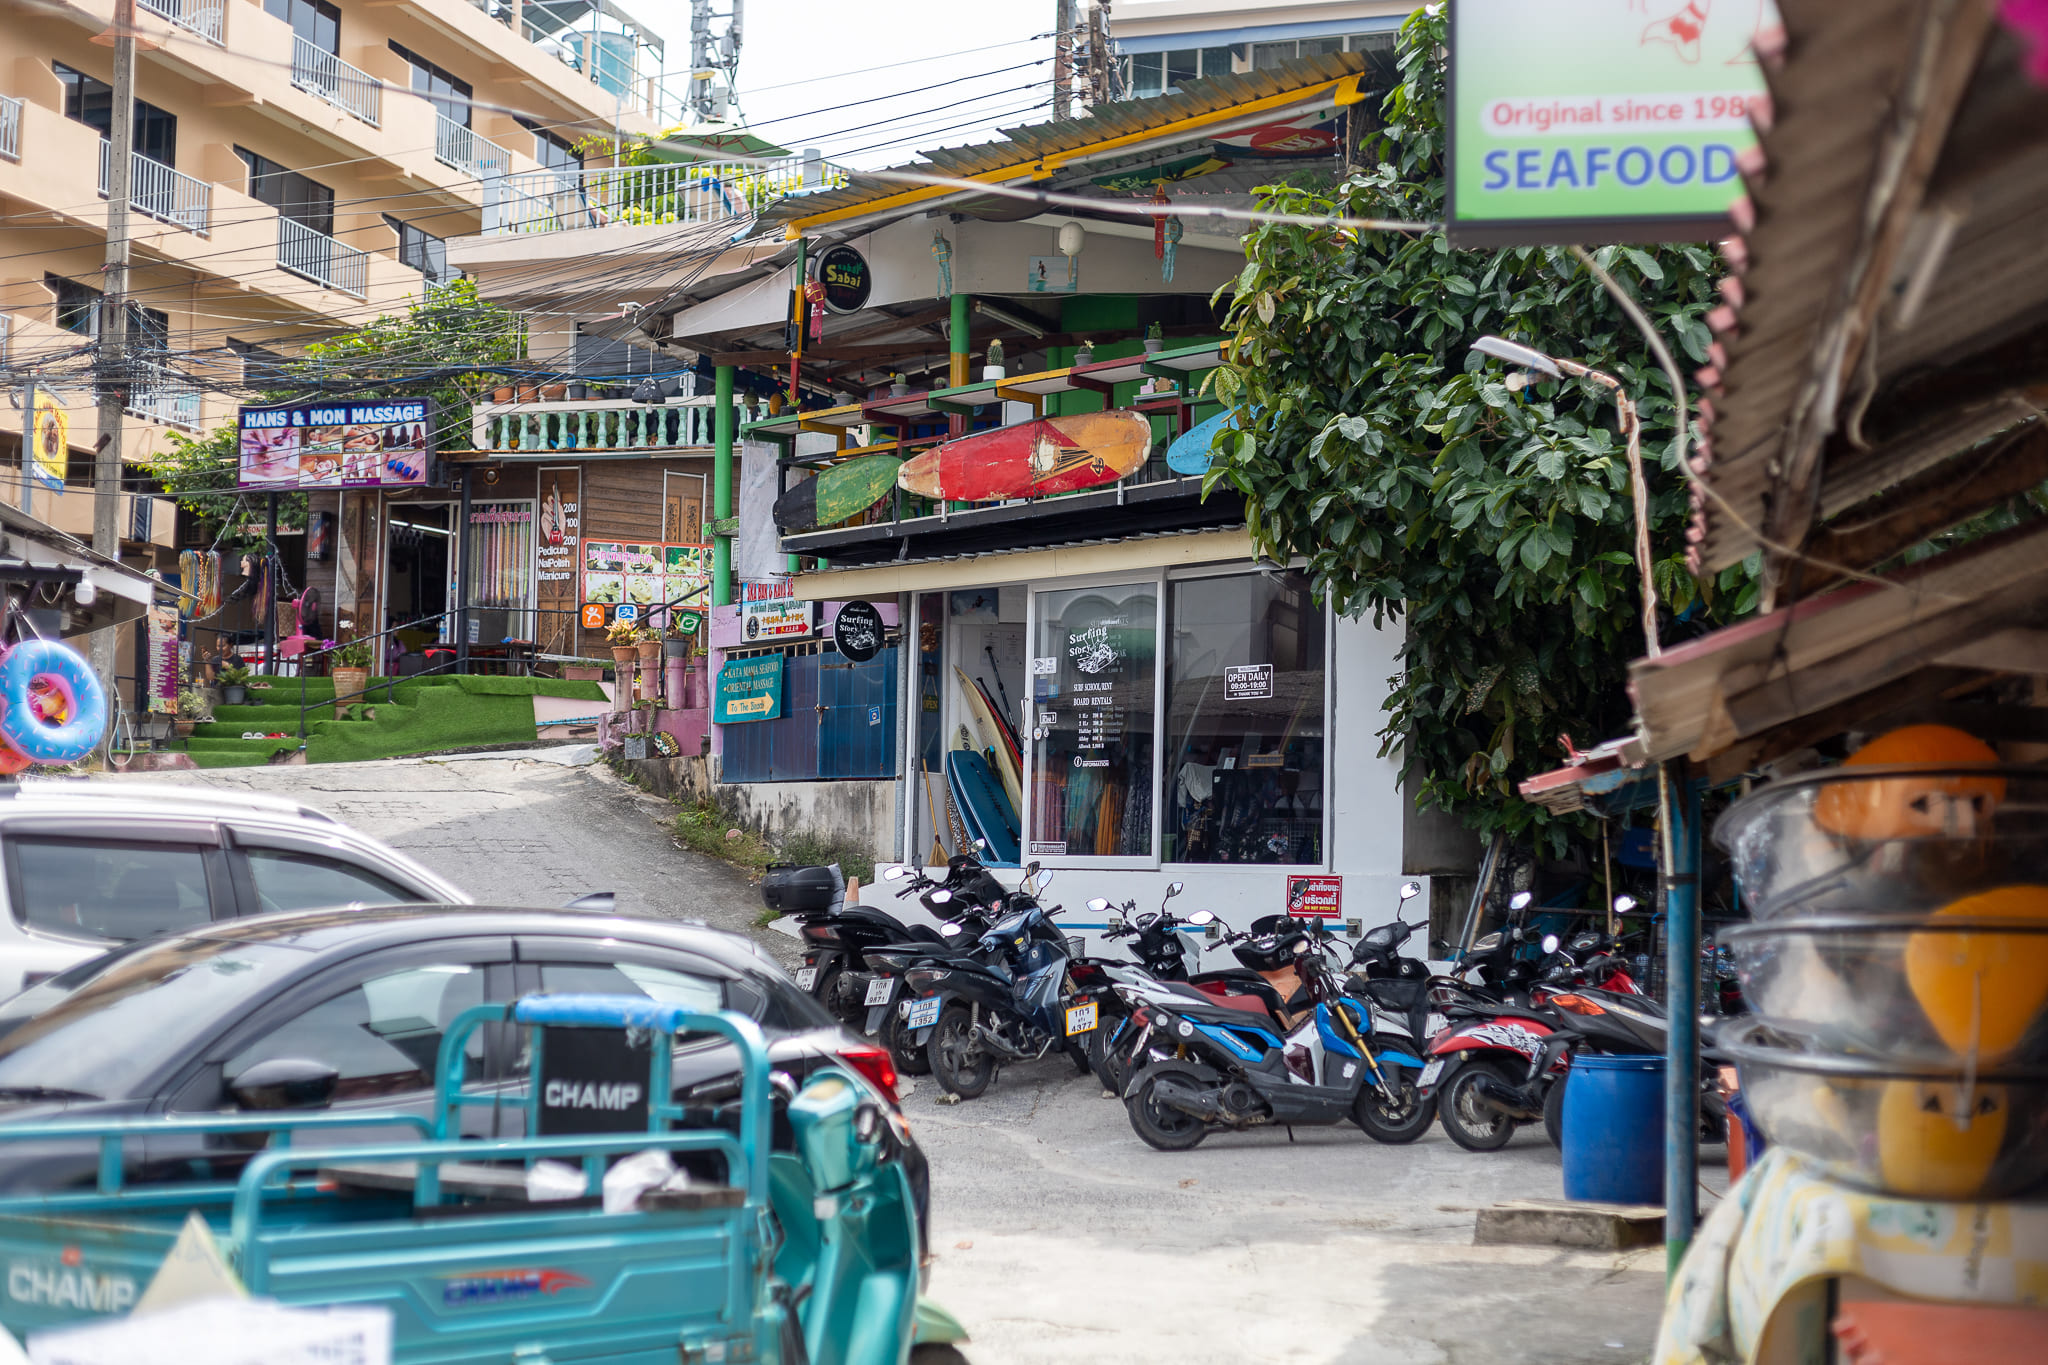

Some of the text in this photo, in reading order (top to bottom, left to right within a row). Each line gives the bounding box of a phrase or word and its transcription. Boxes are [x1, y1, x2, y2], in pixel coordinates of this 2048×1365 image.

[1492, 96, 1747, 132] Original since 198
[1483, 143, 1739, 190] SEAFOOD
[826, 264, 861, 288] Sabai
[244, 405, 423, 428] HANS & MON MASSAGE
[563, 503, 577, 513] 200
[566, 518, 578, 528] 100
[563, 536, 576, 546] 200
[538, 545, 568, 556] Pedicure
[538, 571, 570, 581] Manicure
[840, 614, 874, 627] Surfing
[1069, 626, 1107, 645] Surfing
[727, 661, 779, 679] KATA MAMA SEAFOOD
[1228, 671, 1269, 683] OPEN DAILY
[726, 677, 774, 693] ORIENTAL MASSAGE
[1230, 681, 1267, 690] 09:00-19:00
[731, 700, 765, 712] To The Beach
[1073, 696, 1113, 706] BOARD RENTALS
[914, 1016, 933, 1027] 1352
[1071, 1021, 1092, 1033] 4377
[545, 1081, 641, 1111] CHAMP
[8, 1264, 136, 1313] CHAMP
